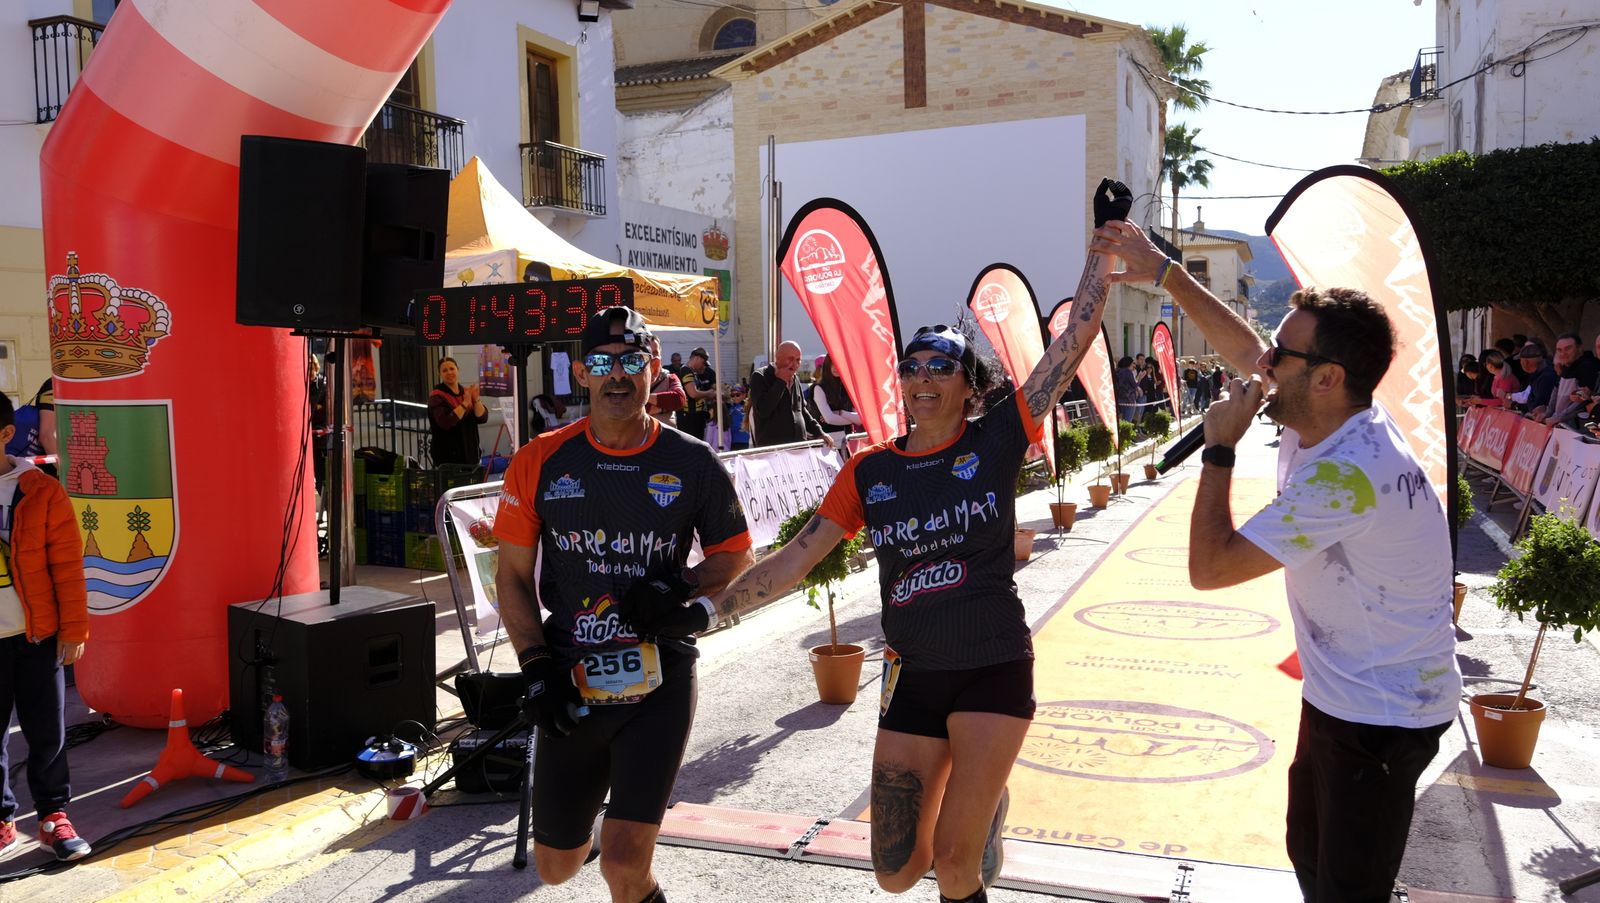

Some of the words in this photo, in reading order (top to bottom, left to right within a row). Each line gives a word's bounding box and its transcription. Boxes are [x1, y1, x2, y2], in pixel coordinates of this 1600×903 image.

[625, 221, 697, 249] EXCELENTÍSIMO
[628, 249, 697, 273] AYUNTAMIENTO
[924, 508, 949, 531] del
[954, 491, 999, 533] MAR
[610, 531, 635, 555] del
[900, 543, 928, 559] todo
[586, 558, 612, 575] todo
[584, 651, 641, 677] 256
[1065, 660, 1243, 679] Ayuntamiento
[1084, 655, 1190, 667] Cantoria
[1198, 661, 1229, 669] de
[1194, 723, 1237, 734] LA
[526, 734, 536, 763] VONYX
[1138, 840, 1189, 856] de
